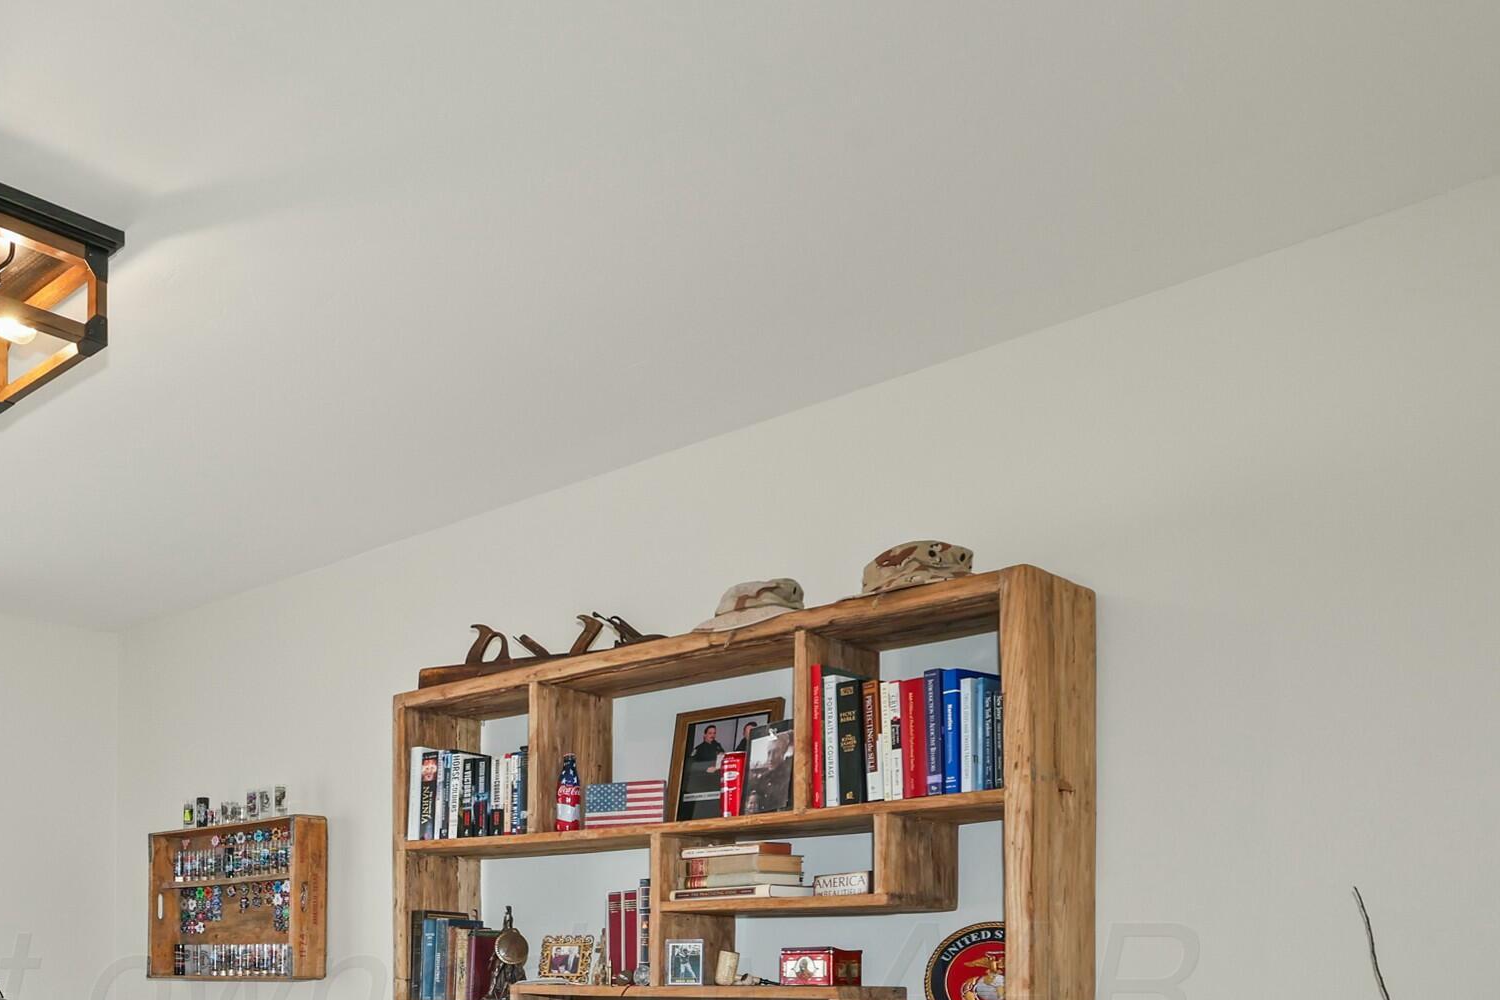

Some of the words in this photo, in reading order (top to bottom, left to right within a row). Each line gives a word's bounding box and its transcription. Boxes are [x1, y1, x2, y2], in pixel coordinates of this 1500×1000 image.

[927, 679, 935, 715] INTRODUCTION
[865, 695, 873, 743] PROTECTING
[451, 755, 460, 781] HORSE
[421, 787, 430, 824] NARNIA
[450, 784, 458, 812] SOLDIERS
[815, 875, 866, 889] AMERICA
[941, 930, 992, 962] UNITED
